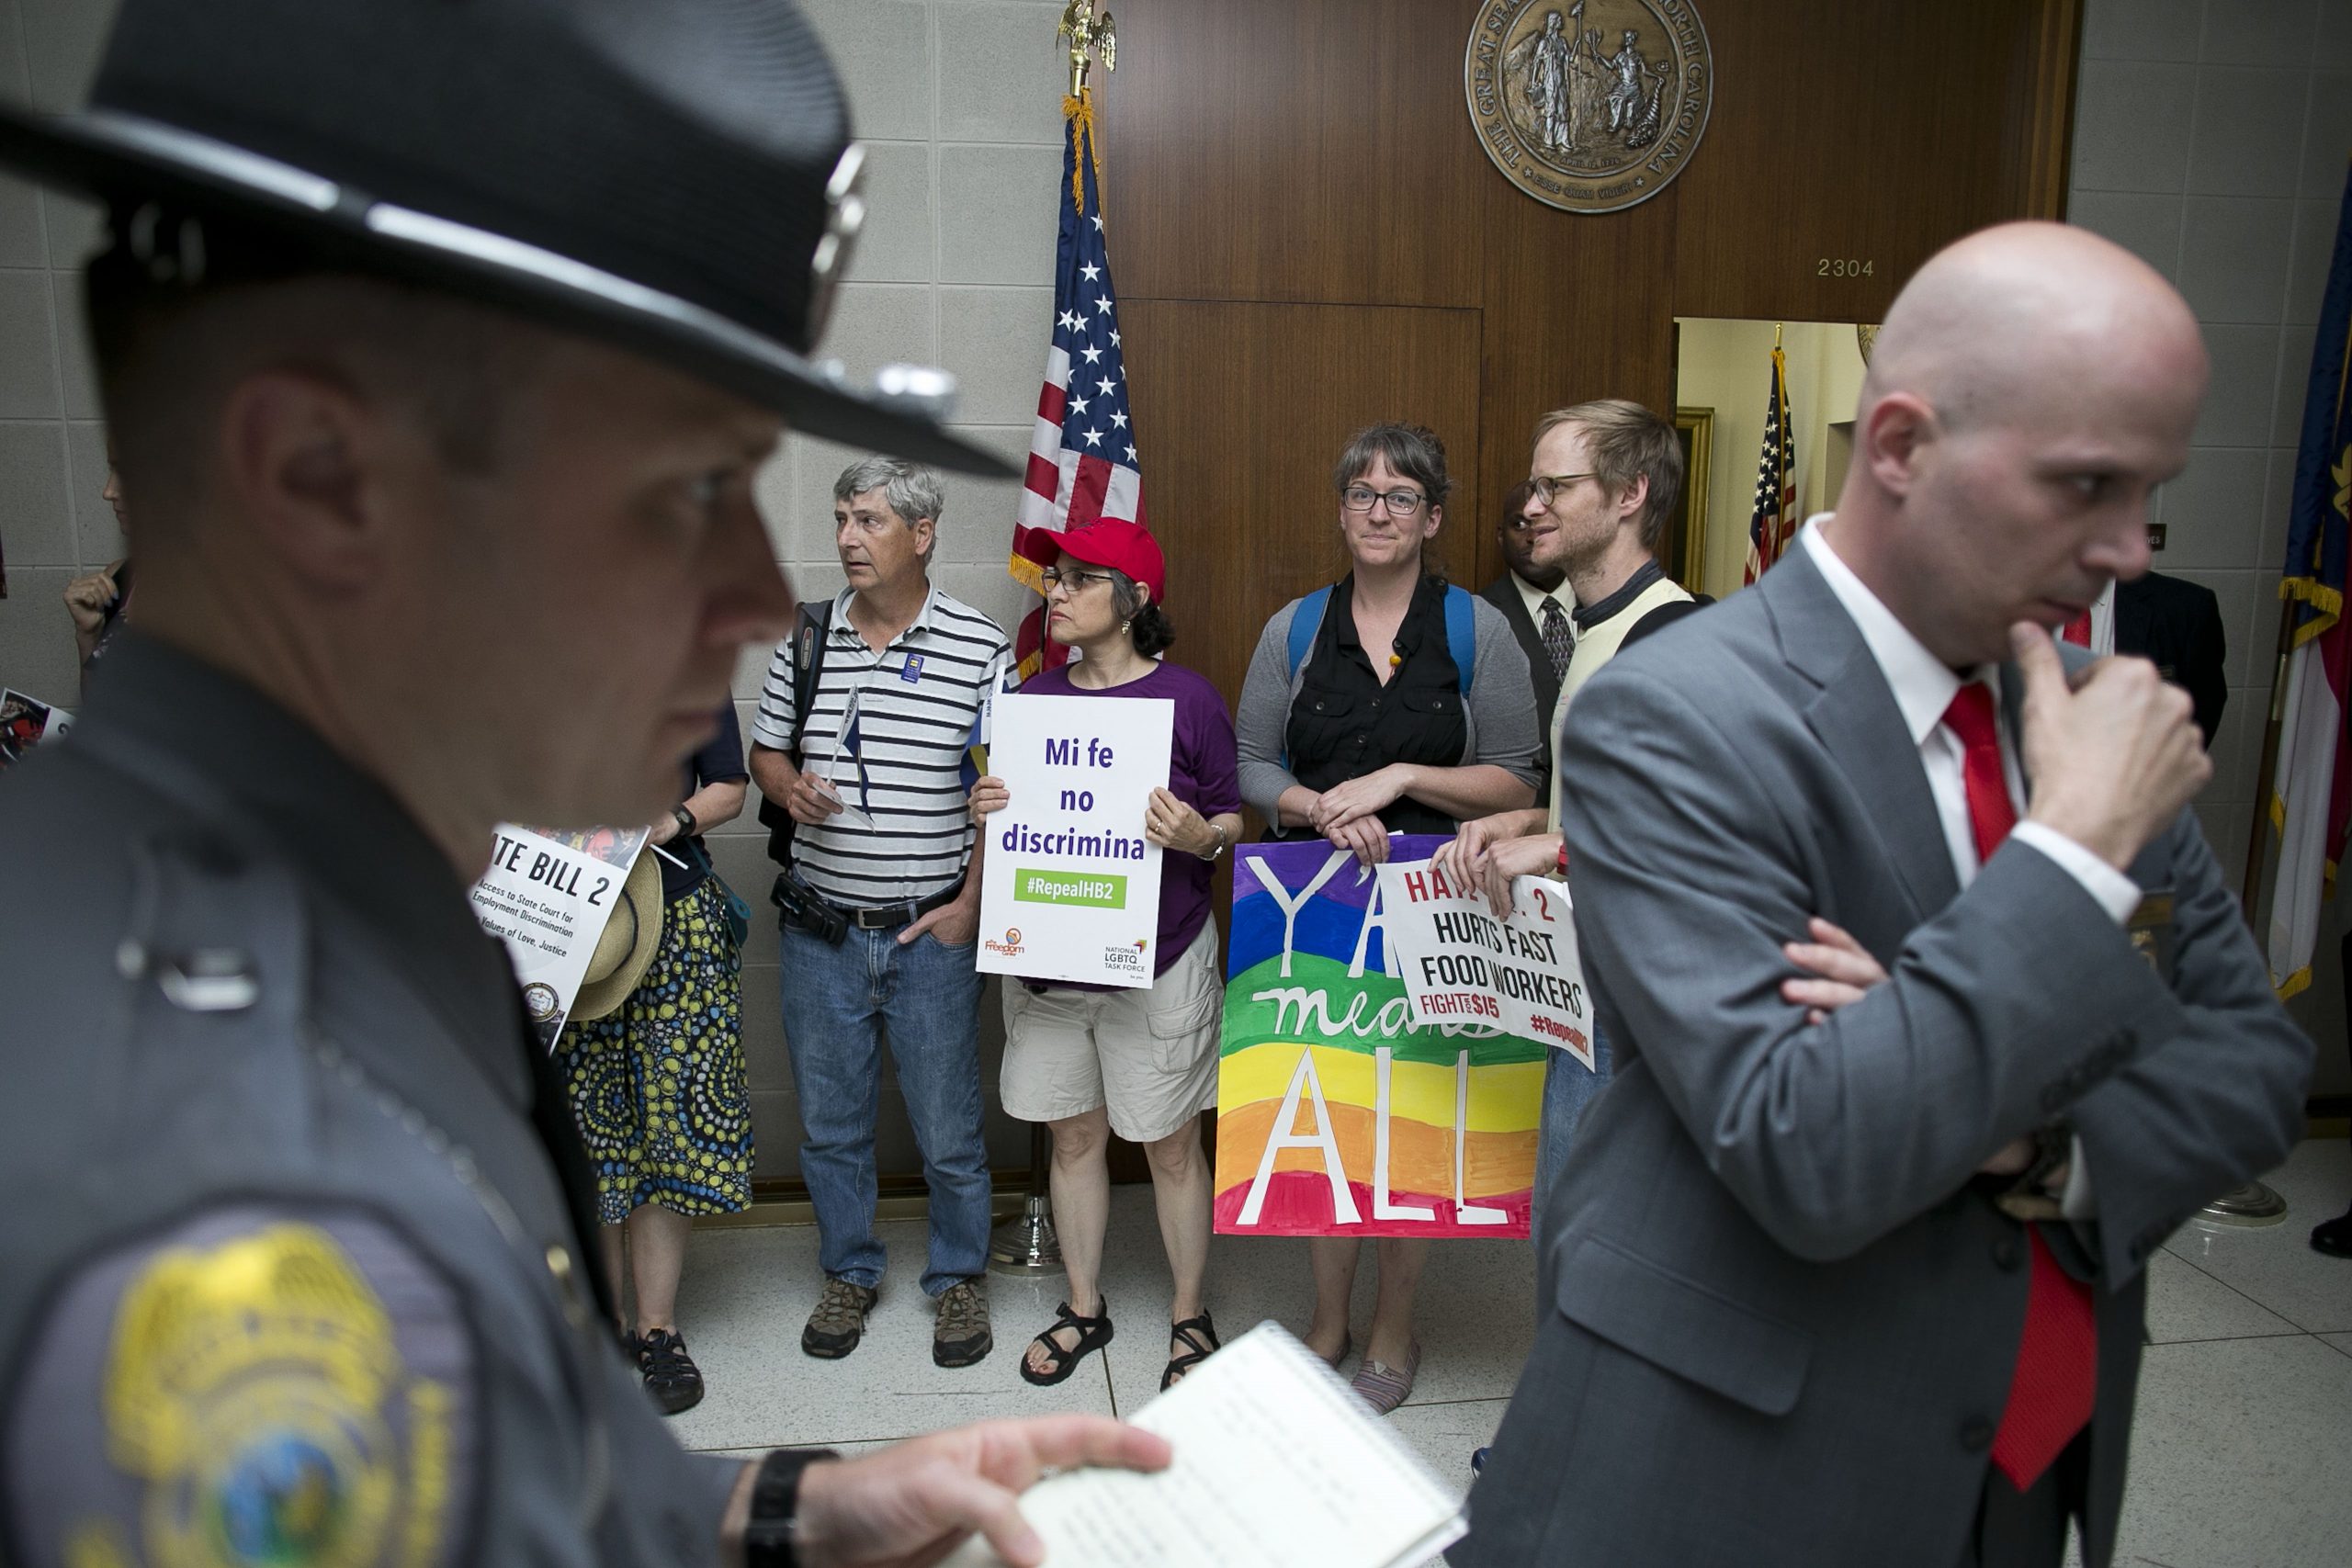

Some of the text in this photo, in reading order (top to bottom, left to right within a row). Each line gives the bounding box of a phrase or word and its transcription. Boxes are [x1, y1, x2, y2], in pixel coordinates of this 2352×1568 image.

[1658, 0, 1701, 57] ORTH
[1475, 34, 1497, 116] GREAT
[1647, 62, 1702, 174] CAROLINA
[1487, 120, 1521, 169] THE
[1534, 175, 1560, 193] ESSE
[1817, 258, 1873, 277] 2304
[1046, 738, 1114, 768] Mi fe
[1060, 790, 1093, 812] no
[1002, 823, 1145, 860] discrimina
[528, 852, 582, 897] BILL
[587, 876, 610, 907] 2
[1027, 876, 1114, 900] #RepealHB2
[1404, 868, 1555, 922] HA 2
[472, 890, 573, 938] Employment Discrimination
[478, 878, 573, 924] Access to State Court for
[507, 929, 517, 939] of
[517, 931, 536, 947] Love,
[538, 941, 567, 957] Justice
[985, 941, 1024, 953] Freedom
[1105, 945, 1137, 955] NATIONAL
[1432, 912, 1558, 965] HURTS FAST
[1104, 953, 1137, 964] LGBTQ
[1104, 962, 1146, 973] TASK FORCE
[1420, 954, 1582, 1020] FOOD WORKERS
[1420, 993, 1470, 1015] FIGHT
[1471, 993, 1499, 1019] $15
[1236, 1044, 1509, 1225] ALL
